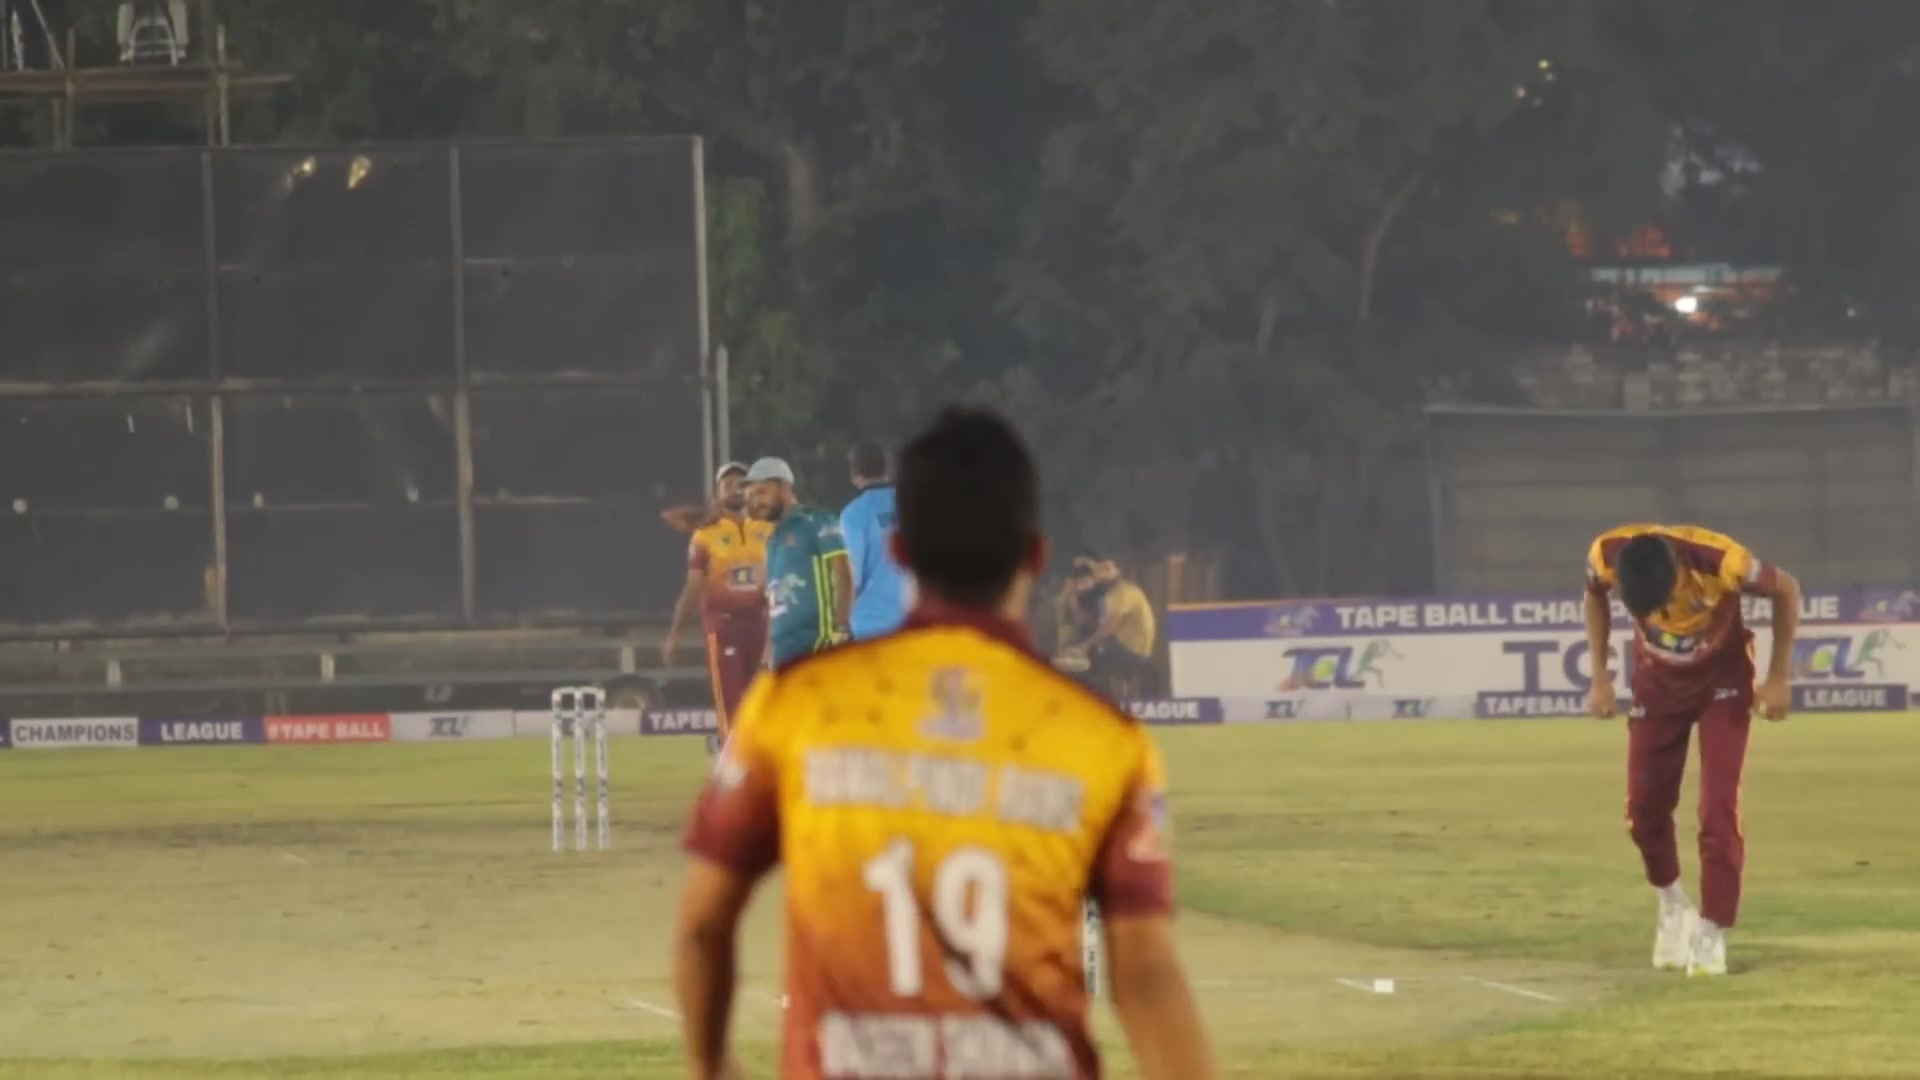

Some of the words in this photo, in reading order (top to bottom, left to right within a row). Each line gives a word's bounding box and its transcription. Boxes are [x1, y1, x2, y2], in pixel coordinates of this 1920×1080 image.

[1336, 605, 1417, 629] TAPE
[1424, 601, 1508, 627] BALL
[1803, 688, 1887, 707] LEAGUE
[650, 710, 718, 730] TAPEB
[15, 723, 136, 742] CHAMPIONS
[161, 721, 243, 741] LEAGUE
[335, 721, 384, 739] BALL
[863, 836, 1009, 999] 19
